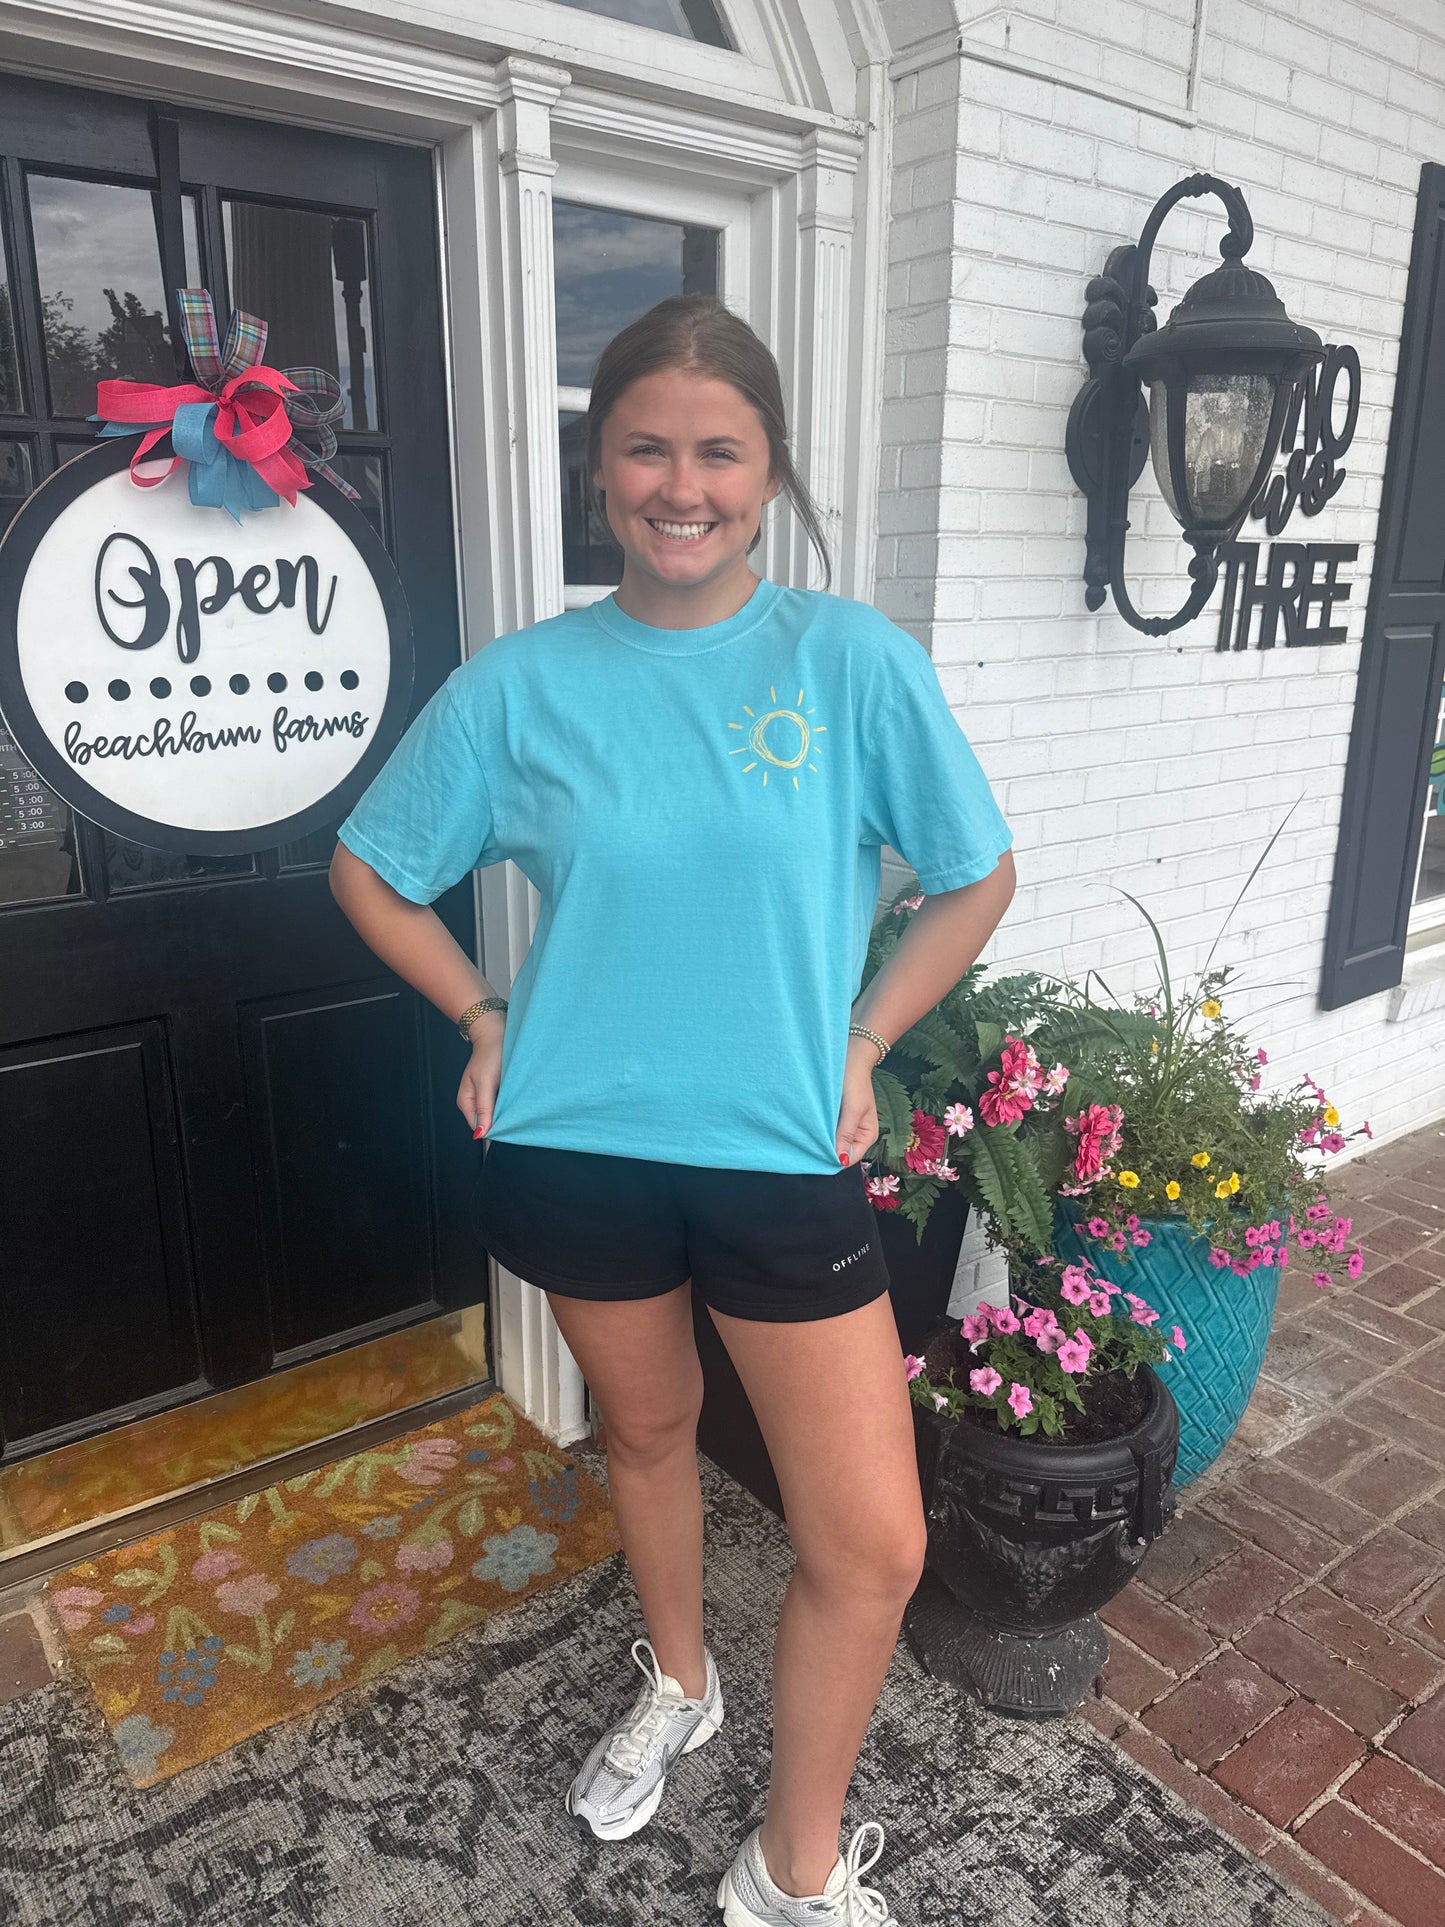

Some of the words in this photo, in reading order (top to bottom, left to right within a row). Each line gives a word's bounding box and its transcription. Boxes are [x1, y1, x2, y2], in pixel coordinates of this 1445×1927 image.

[95, 532, 337, 663] Open
[1214, 542, 1360, 651] THREE
[64, 711, 261, 765] beachbum
[272, 706, 369, 753] farms
[832, 1243, 870, 1272] OFFLINE
